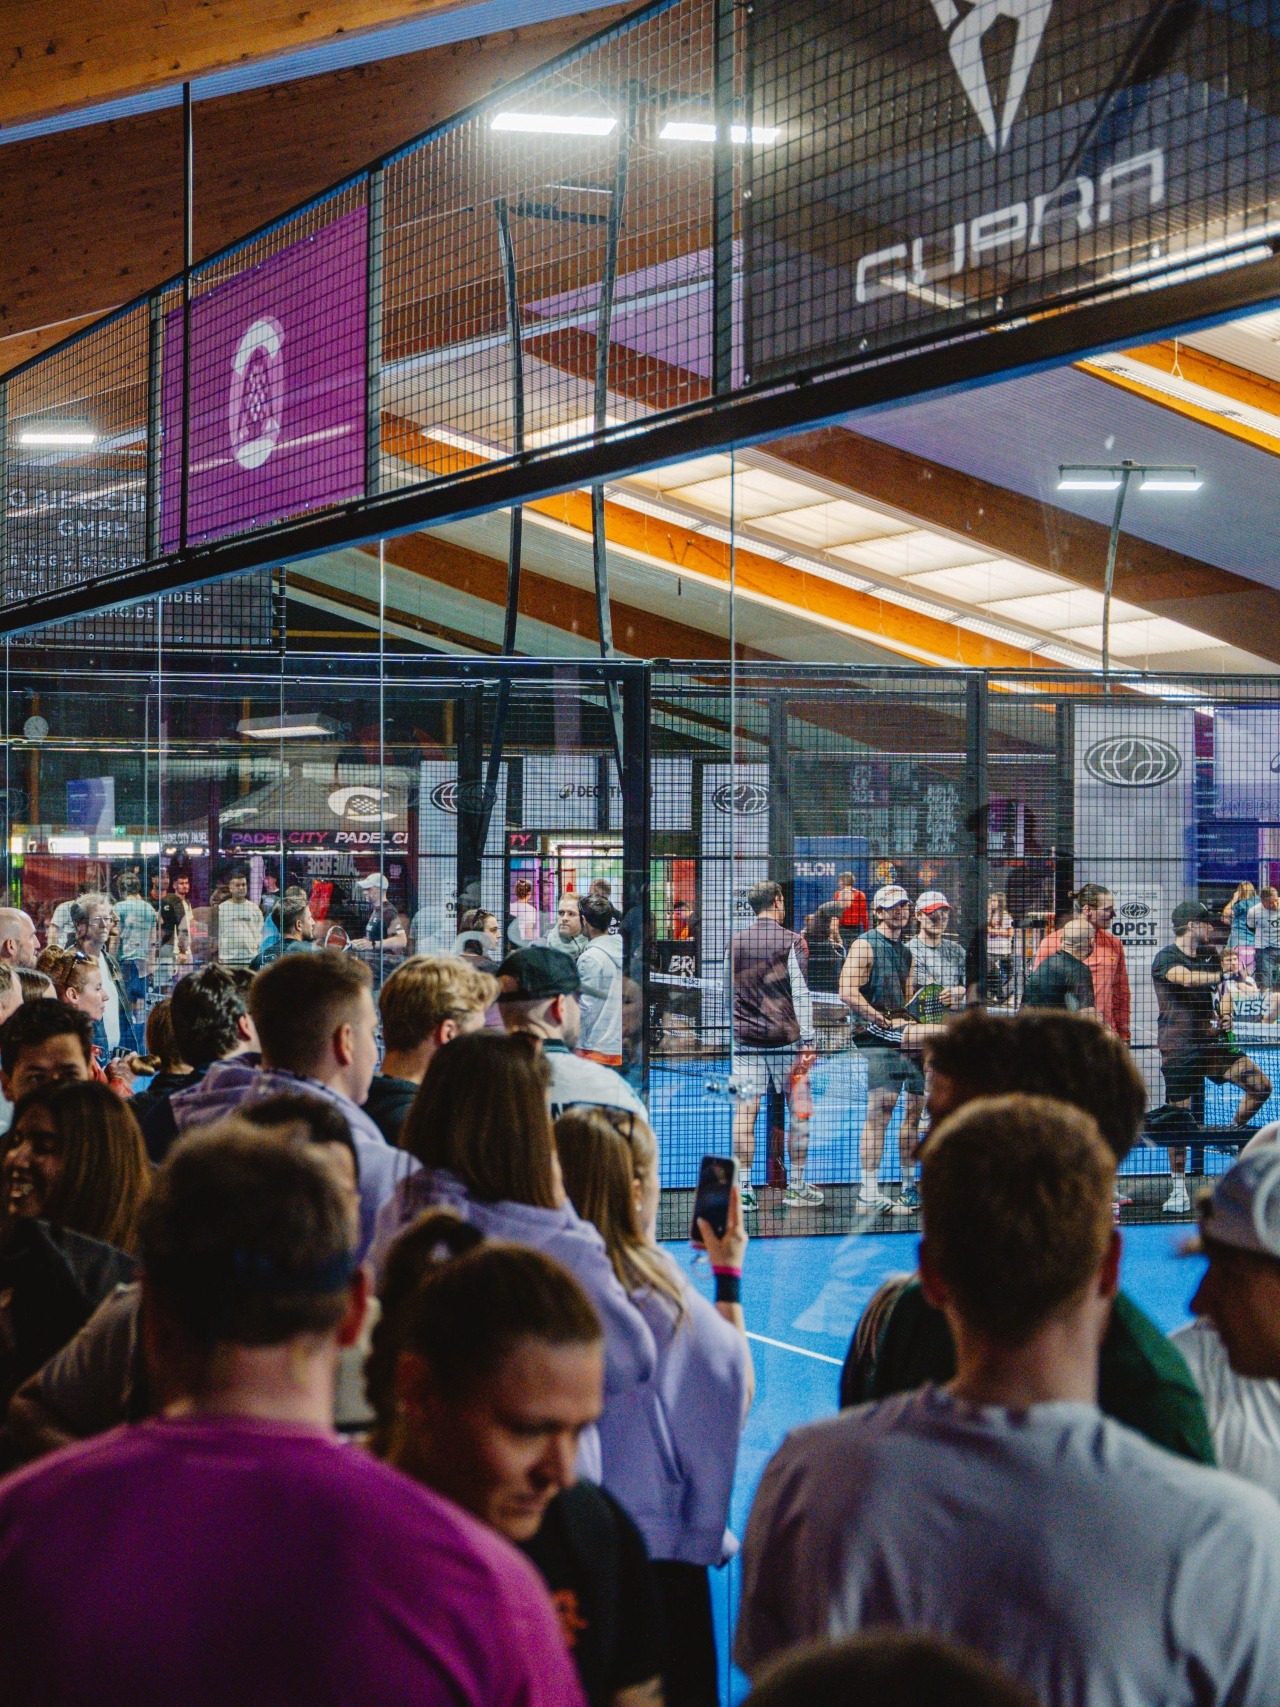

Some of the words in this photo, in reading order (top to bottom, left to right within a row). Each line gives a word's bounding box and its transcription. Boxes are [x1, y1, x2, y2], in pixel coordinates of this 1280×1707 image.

[855, 148, 1166, 303] CUPRA
[509, 834, 532, 846] TY
[1112, 922, 1158, 936] OPCT
